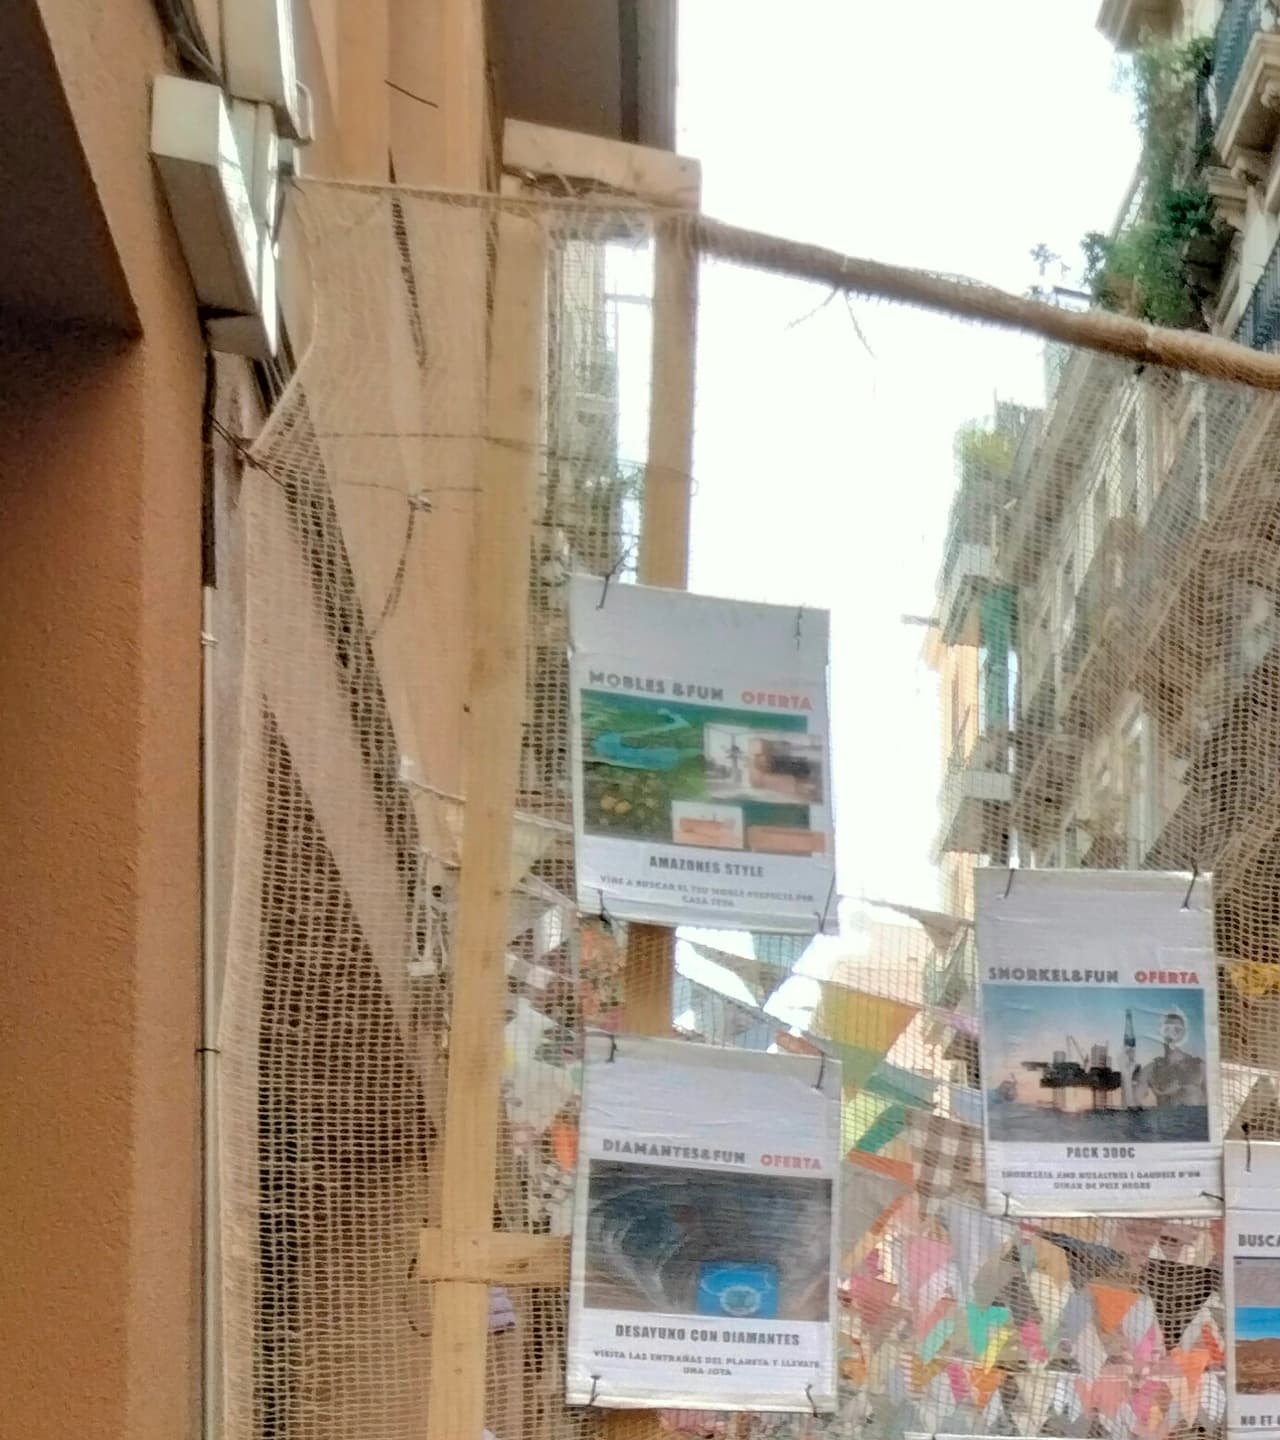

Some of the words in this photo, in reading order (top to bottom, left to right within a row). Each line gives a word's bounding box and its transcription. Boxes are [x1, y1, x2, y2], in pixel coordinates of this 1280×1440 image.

[589, 670, 665, 694] MOBLES
[741, 691, 813, 711] OFERTA
[725, 863, 765, 877] STYLE
[988, 967, 1118, 983] SNORKEL&FUN
[1134, 970, 1200, 984] OFERTA
[603, 1139, 745, 1164] DIAMANTES&FUN
[760, 1154, 822, 1170] OFERTA
[1066, 1146, 1099, 1159] PACK
[616, 1324, 685, 1341] DESAYUNO
[691, 1329, 718, 1342] CON
[723, 1331, 800, 1347] DIAMANTES
[1240, 1415, 1256, 1426] NO
[1260, 1415, 1273, 1425] ET
